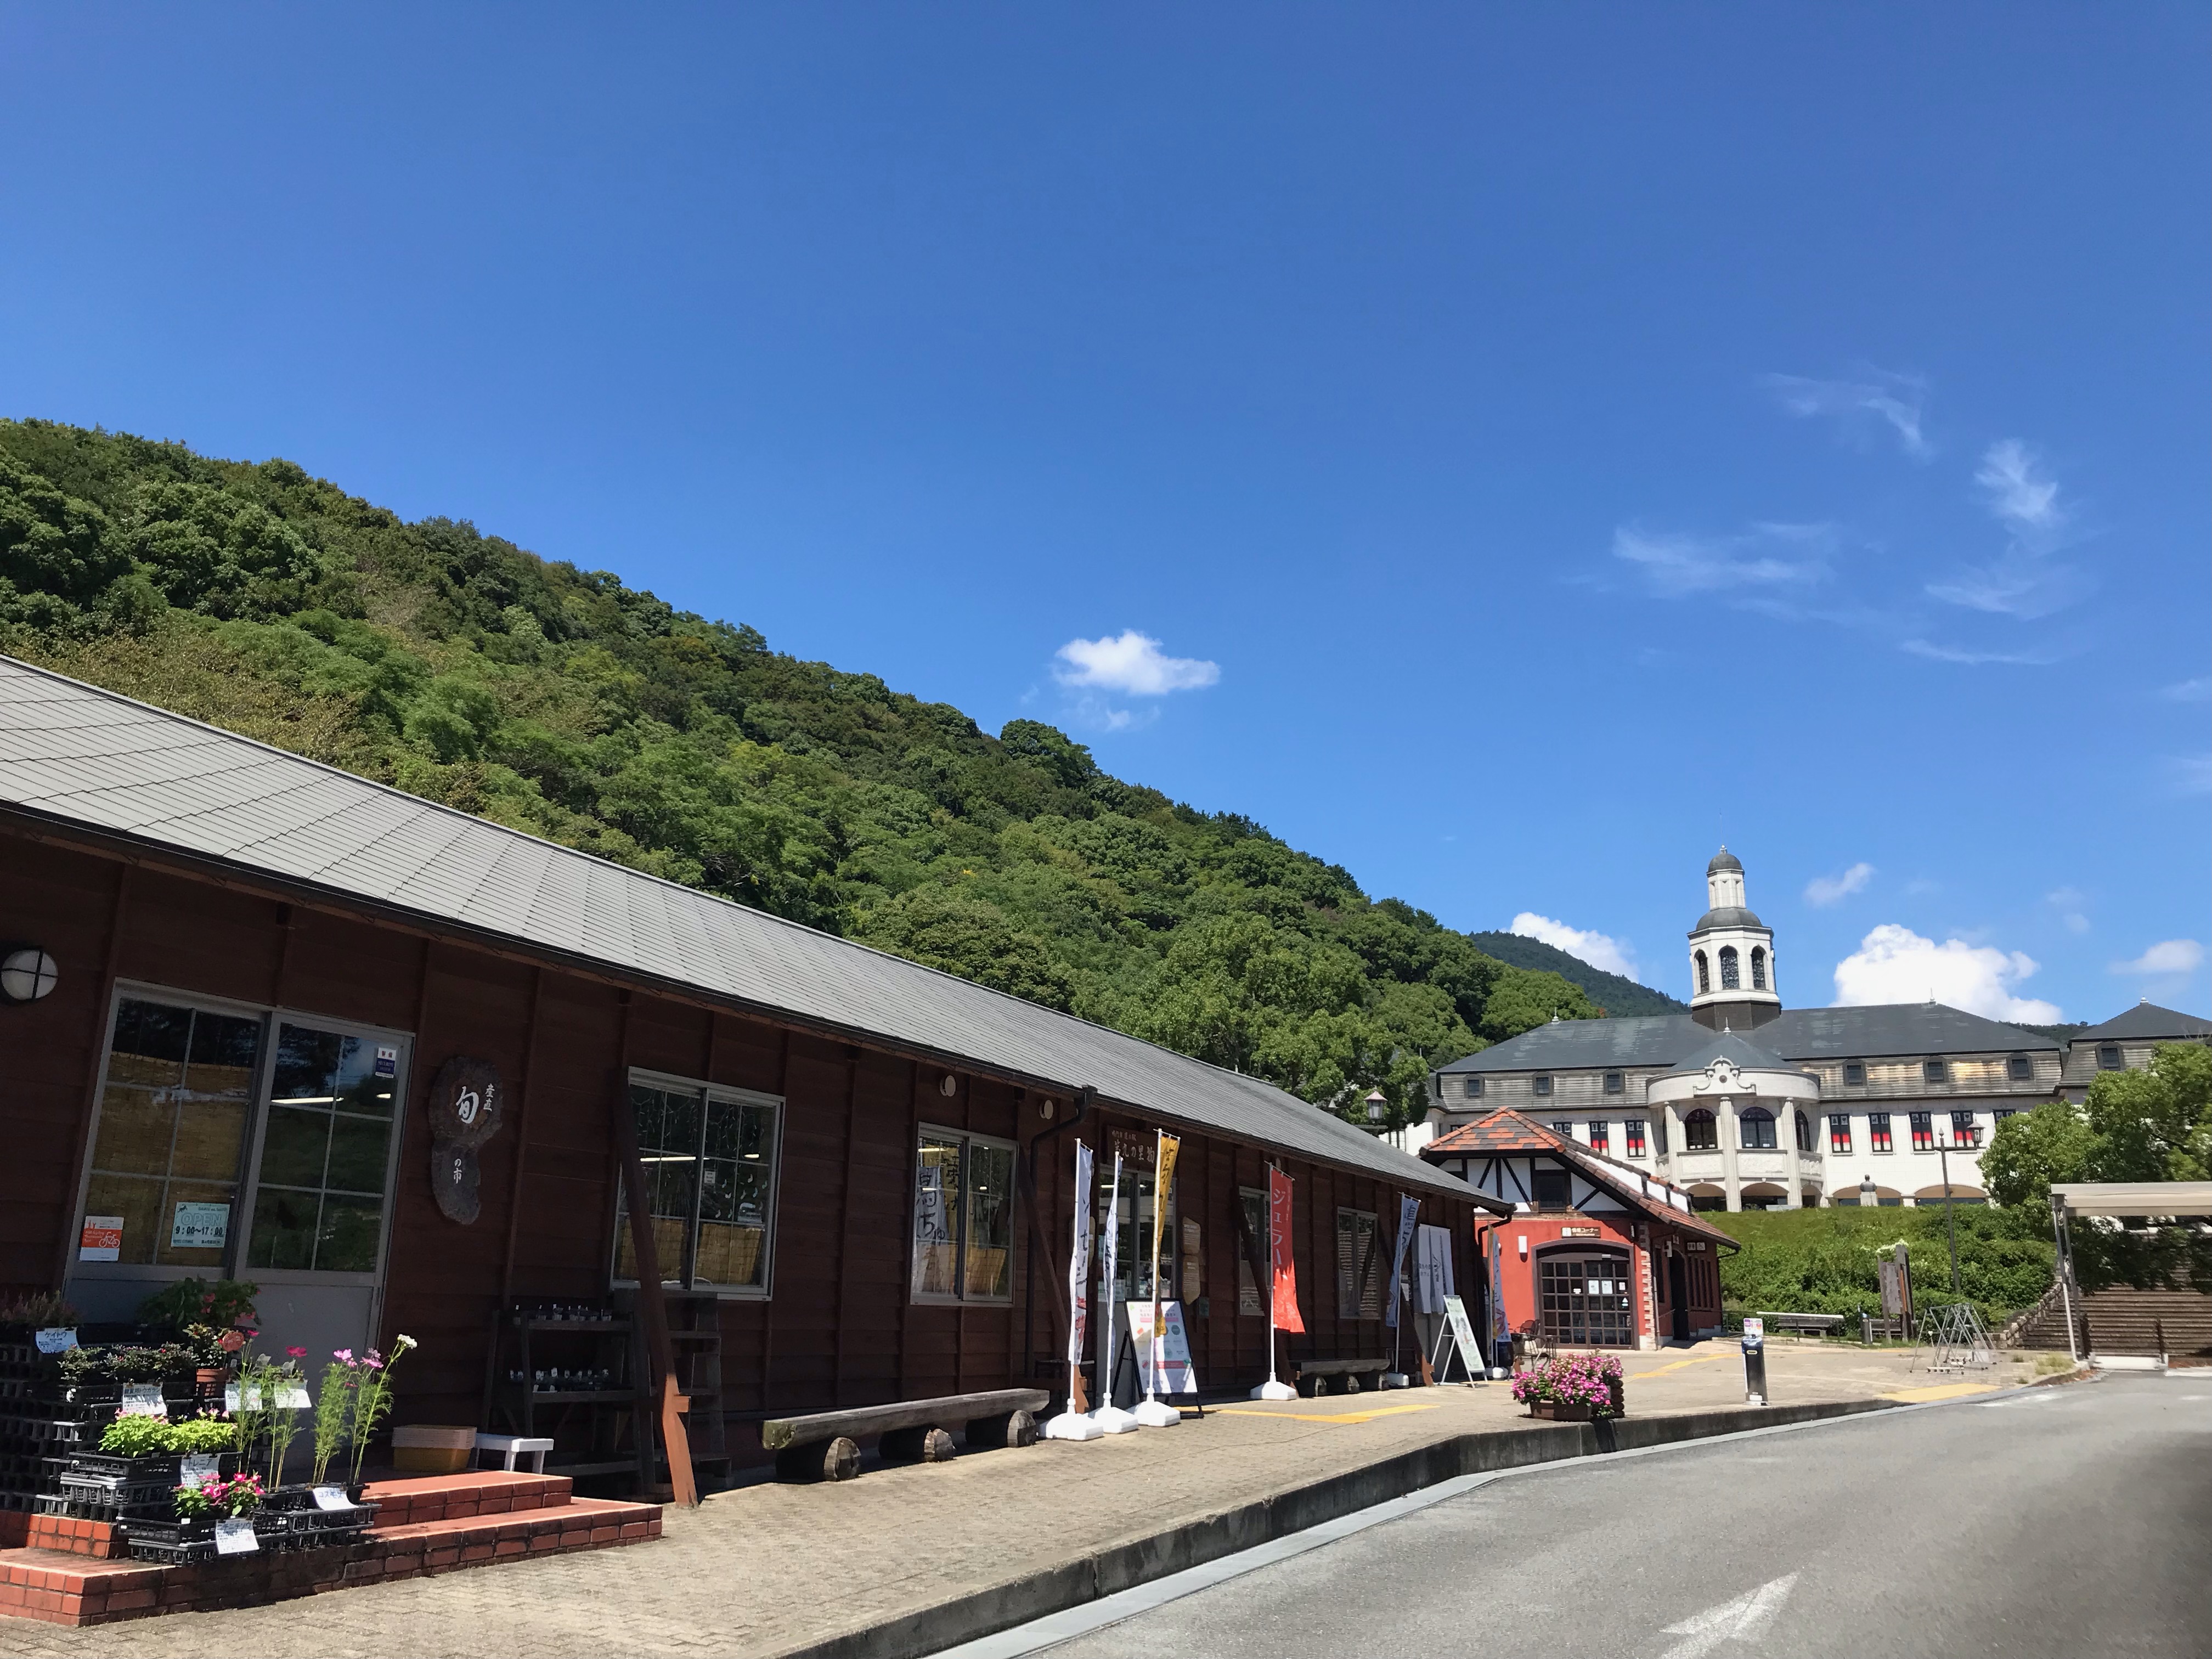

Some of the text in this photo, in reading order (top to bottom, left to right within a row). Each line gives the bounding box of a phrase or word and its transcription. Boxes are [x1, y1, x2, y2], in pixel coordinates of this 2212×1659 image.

[483, 1084, 495, 1112] 産直
[453, 1158, 462, 1184] の市
[181, 1212, 222, 1227] OPEN
[188, 1458, 213, 1467] トレニア
[318, 1491, 343, 1499] コスモス
